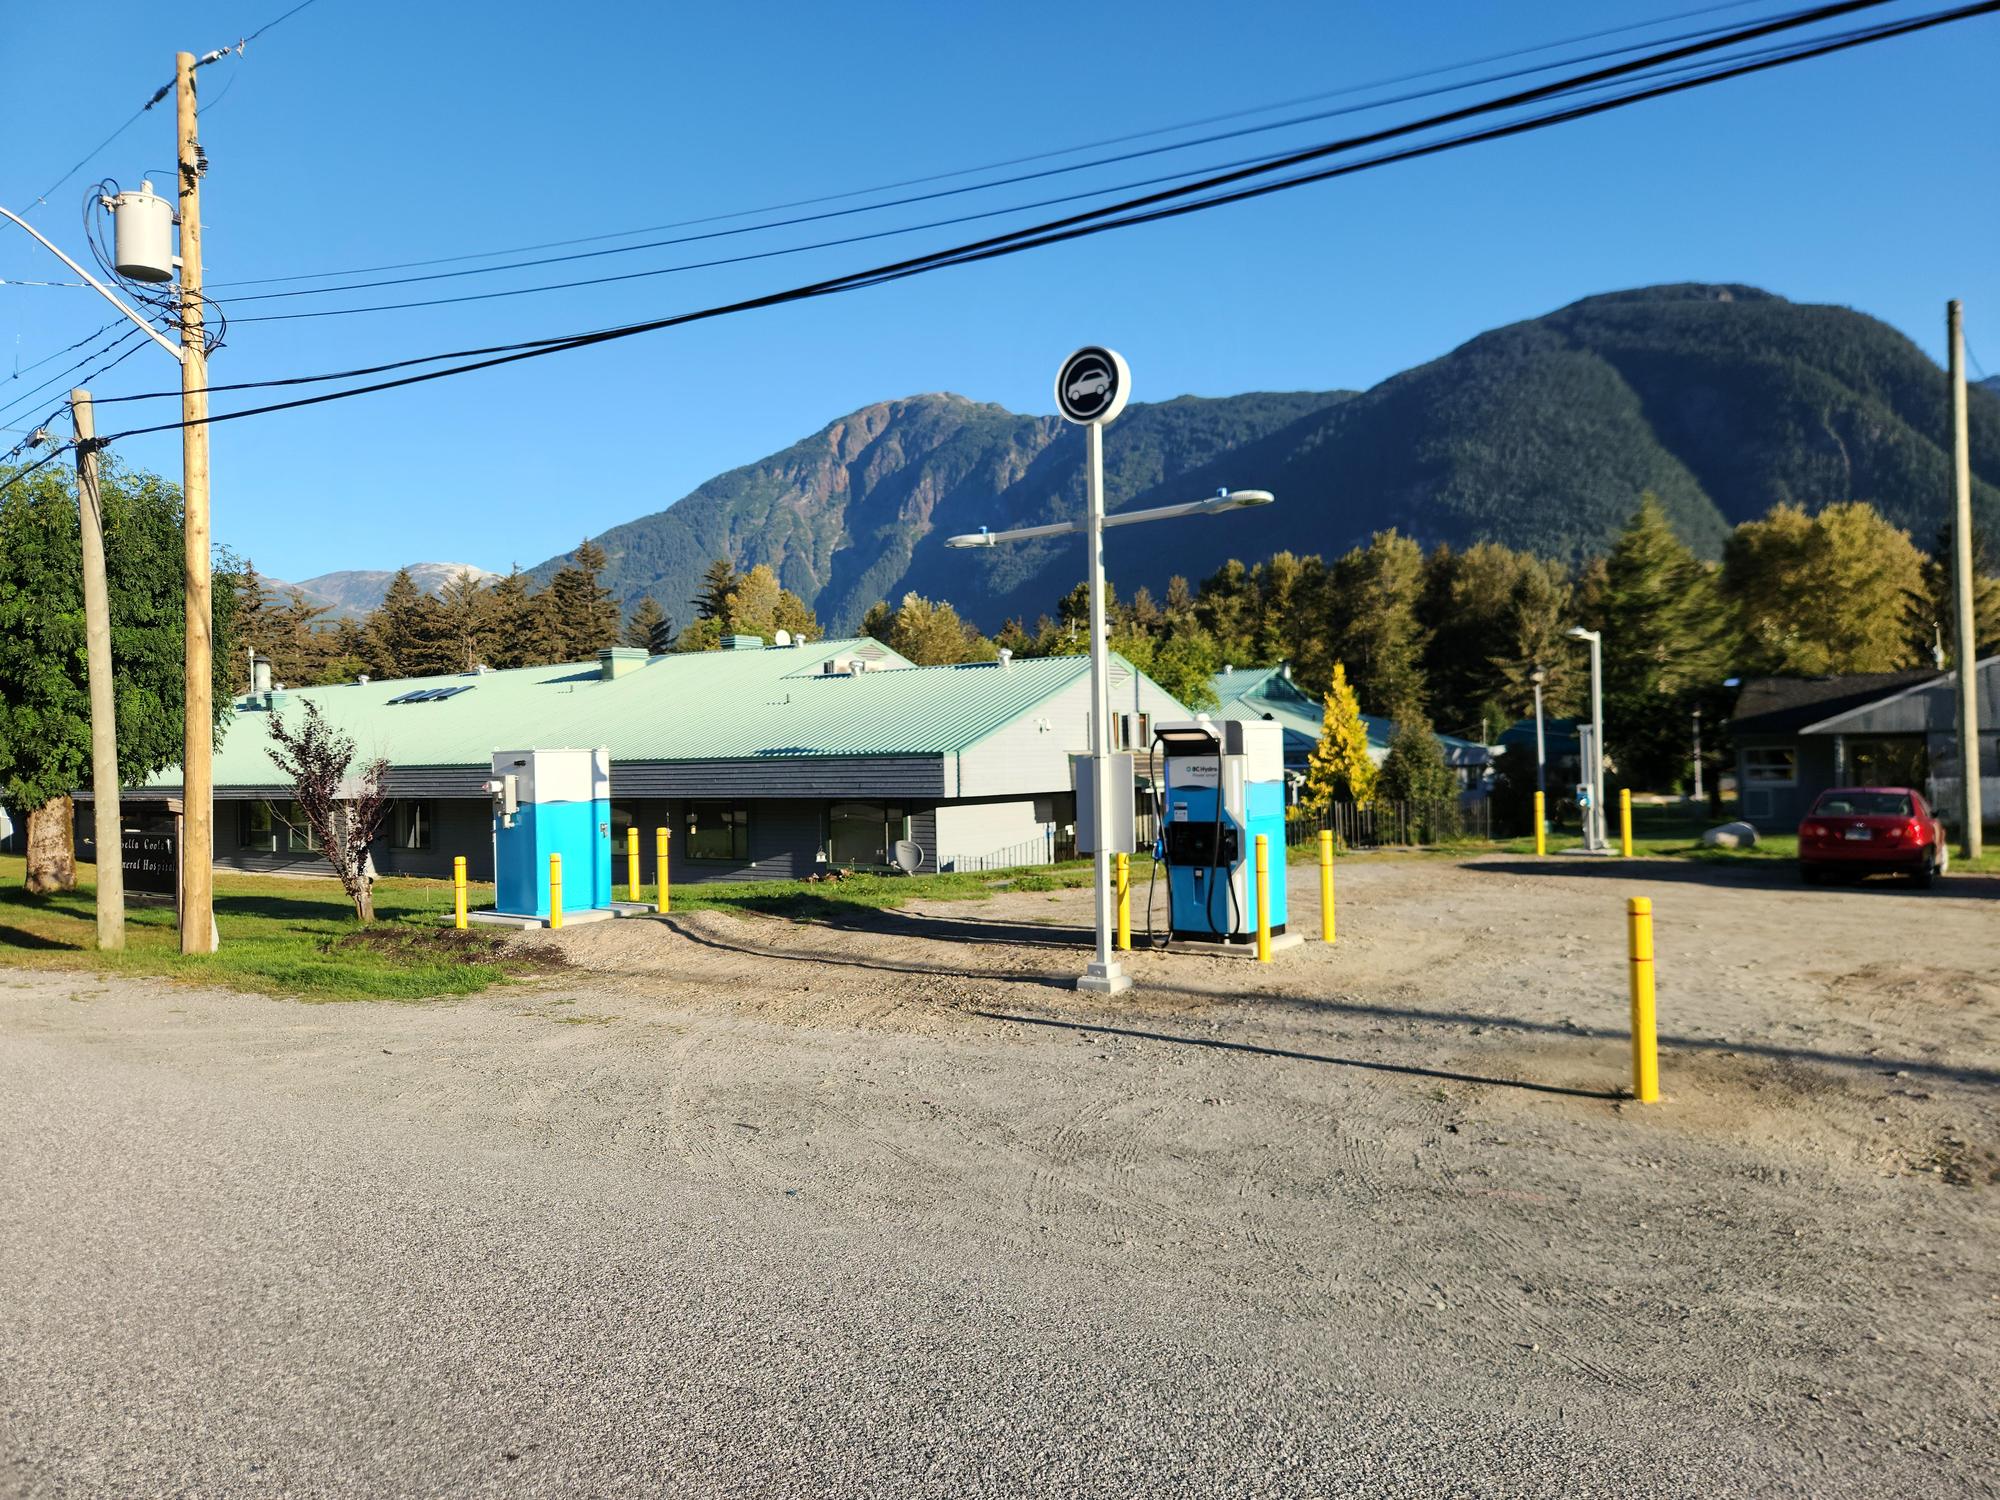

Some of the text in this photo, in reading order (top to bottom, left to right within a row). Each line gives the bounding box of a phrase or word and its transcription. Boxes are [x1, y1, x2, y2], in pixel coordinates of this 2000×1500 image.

[144, 838, 165, 850] Coola
[122, 858, 175, 875] neral Hospital
